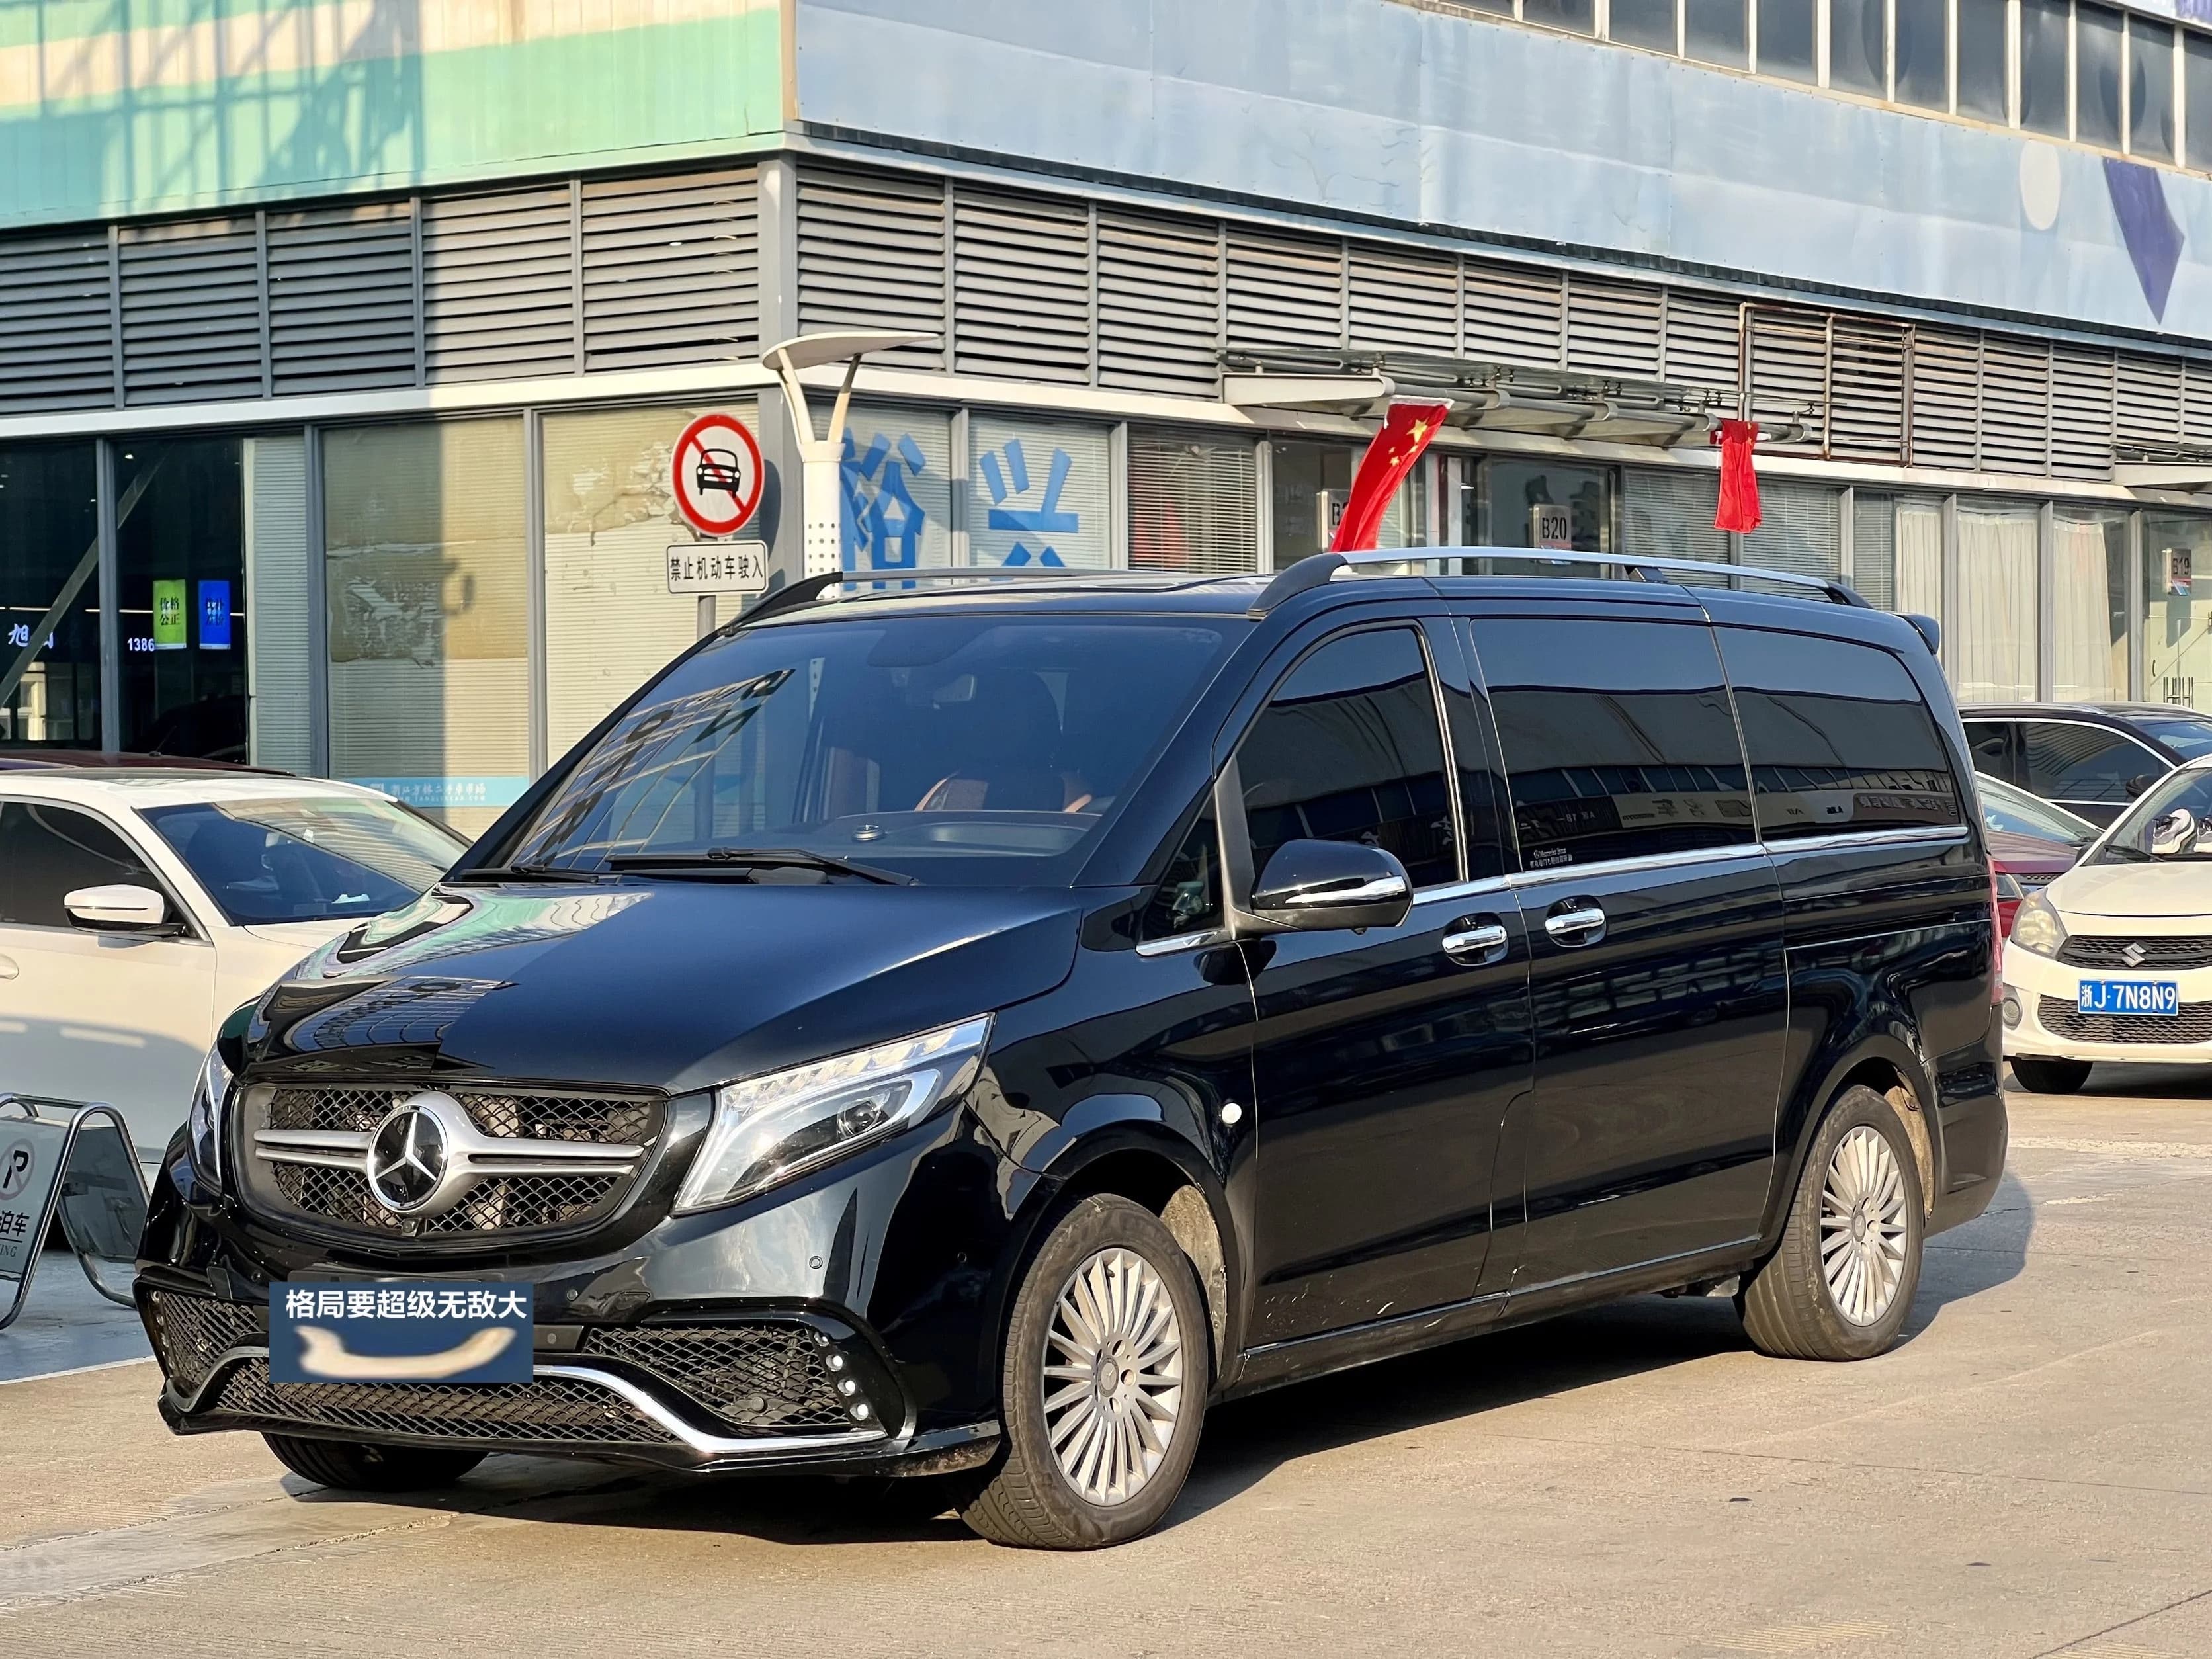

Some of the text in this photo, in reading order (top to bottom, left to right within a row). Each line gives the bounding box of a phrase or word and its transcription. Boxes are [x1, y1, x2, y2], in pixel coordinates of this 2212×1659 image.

[1542, 517, 1567, 540] B20
[670, 554, 763, 582] 禁止机动车驶入
[2173, 557, 2190, 575] B19
[159, 613, 181, 626] 公正
[127, 637, 155, 652] 1386
